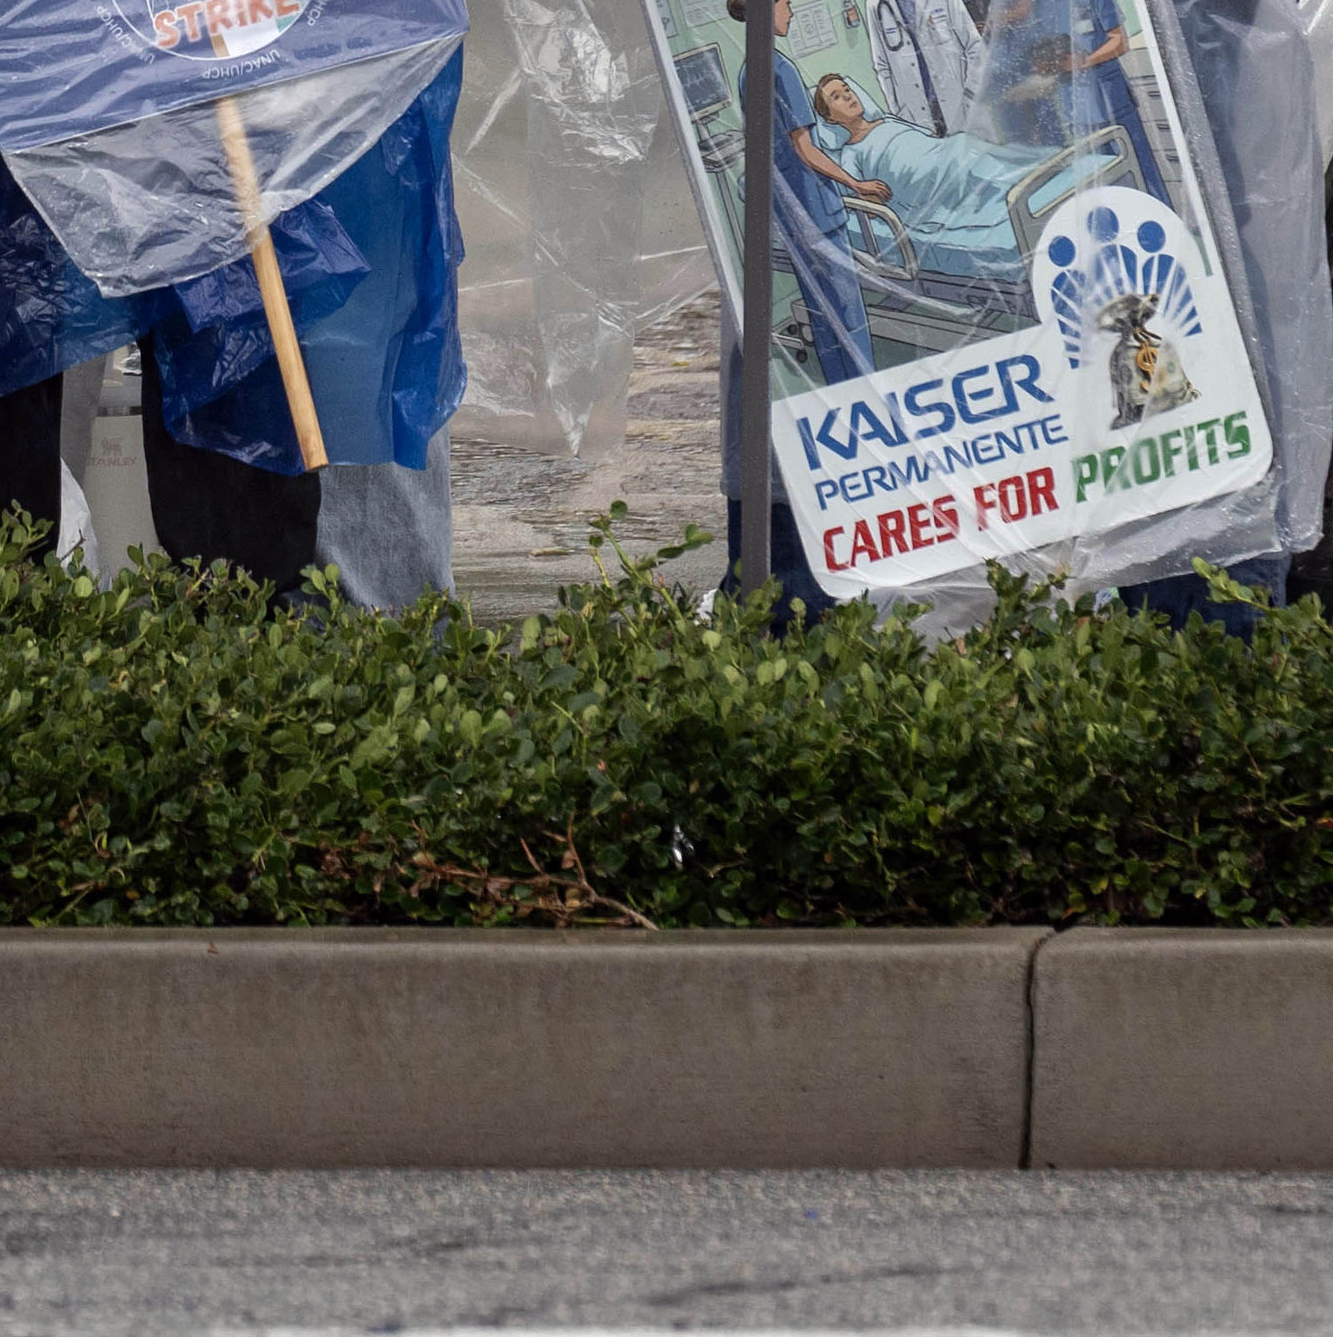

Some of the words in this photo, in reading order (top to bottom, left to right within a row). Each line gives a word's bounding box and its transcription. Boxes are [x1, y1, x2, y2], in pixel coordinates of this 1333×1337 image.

[96, 6, 155, 64] UC/UHCP
[202, 49, 280, 78] UNAC/UHCP
[797, 354, 1055, 471] KAISER
[815, 414, 1069, 511] PERMANENTE
[823, 495, 960, 573] CARES
[973, 466, 1059, 531] FOR
[1070, 411, 1252, 503] PROFITS
